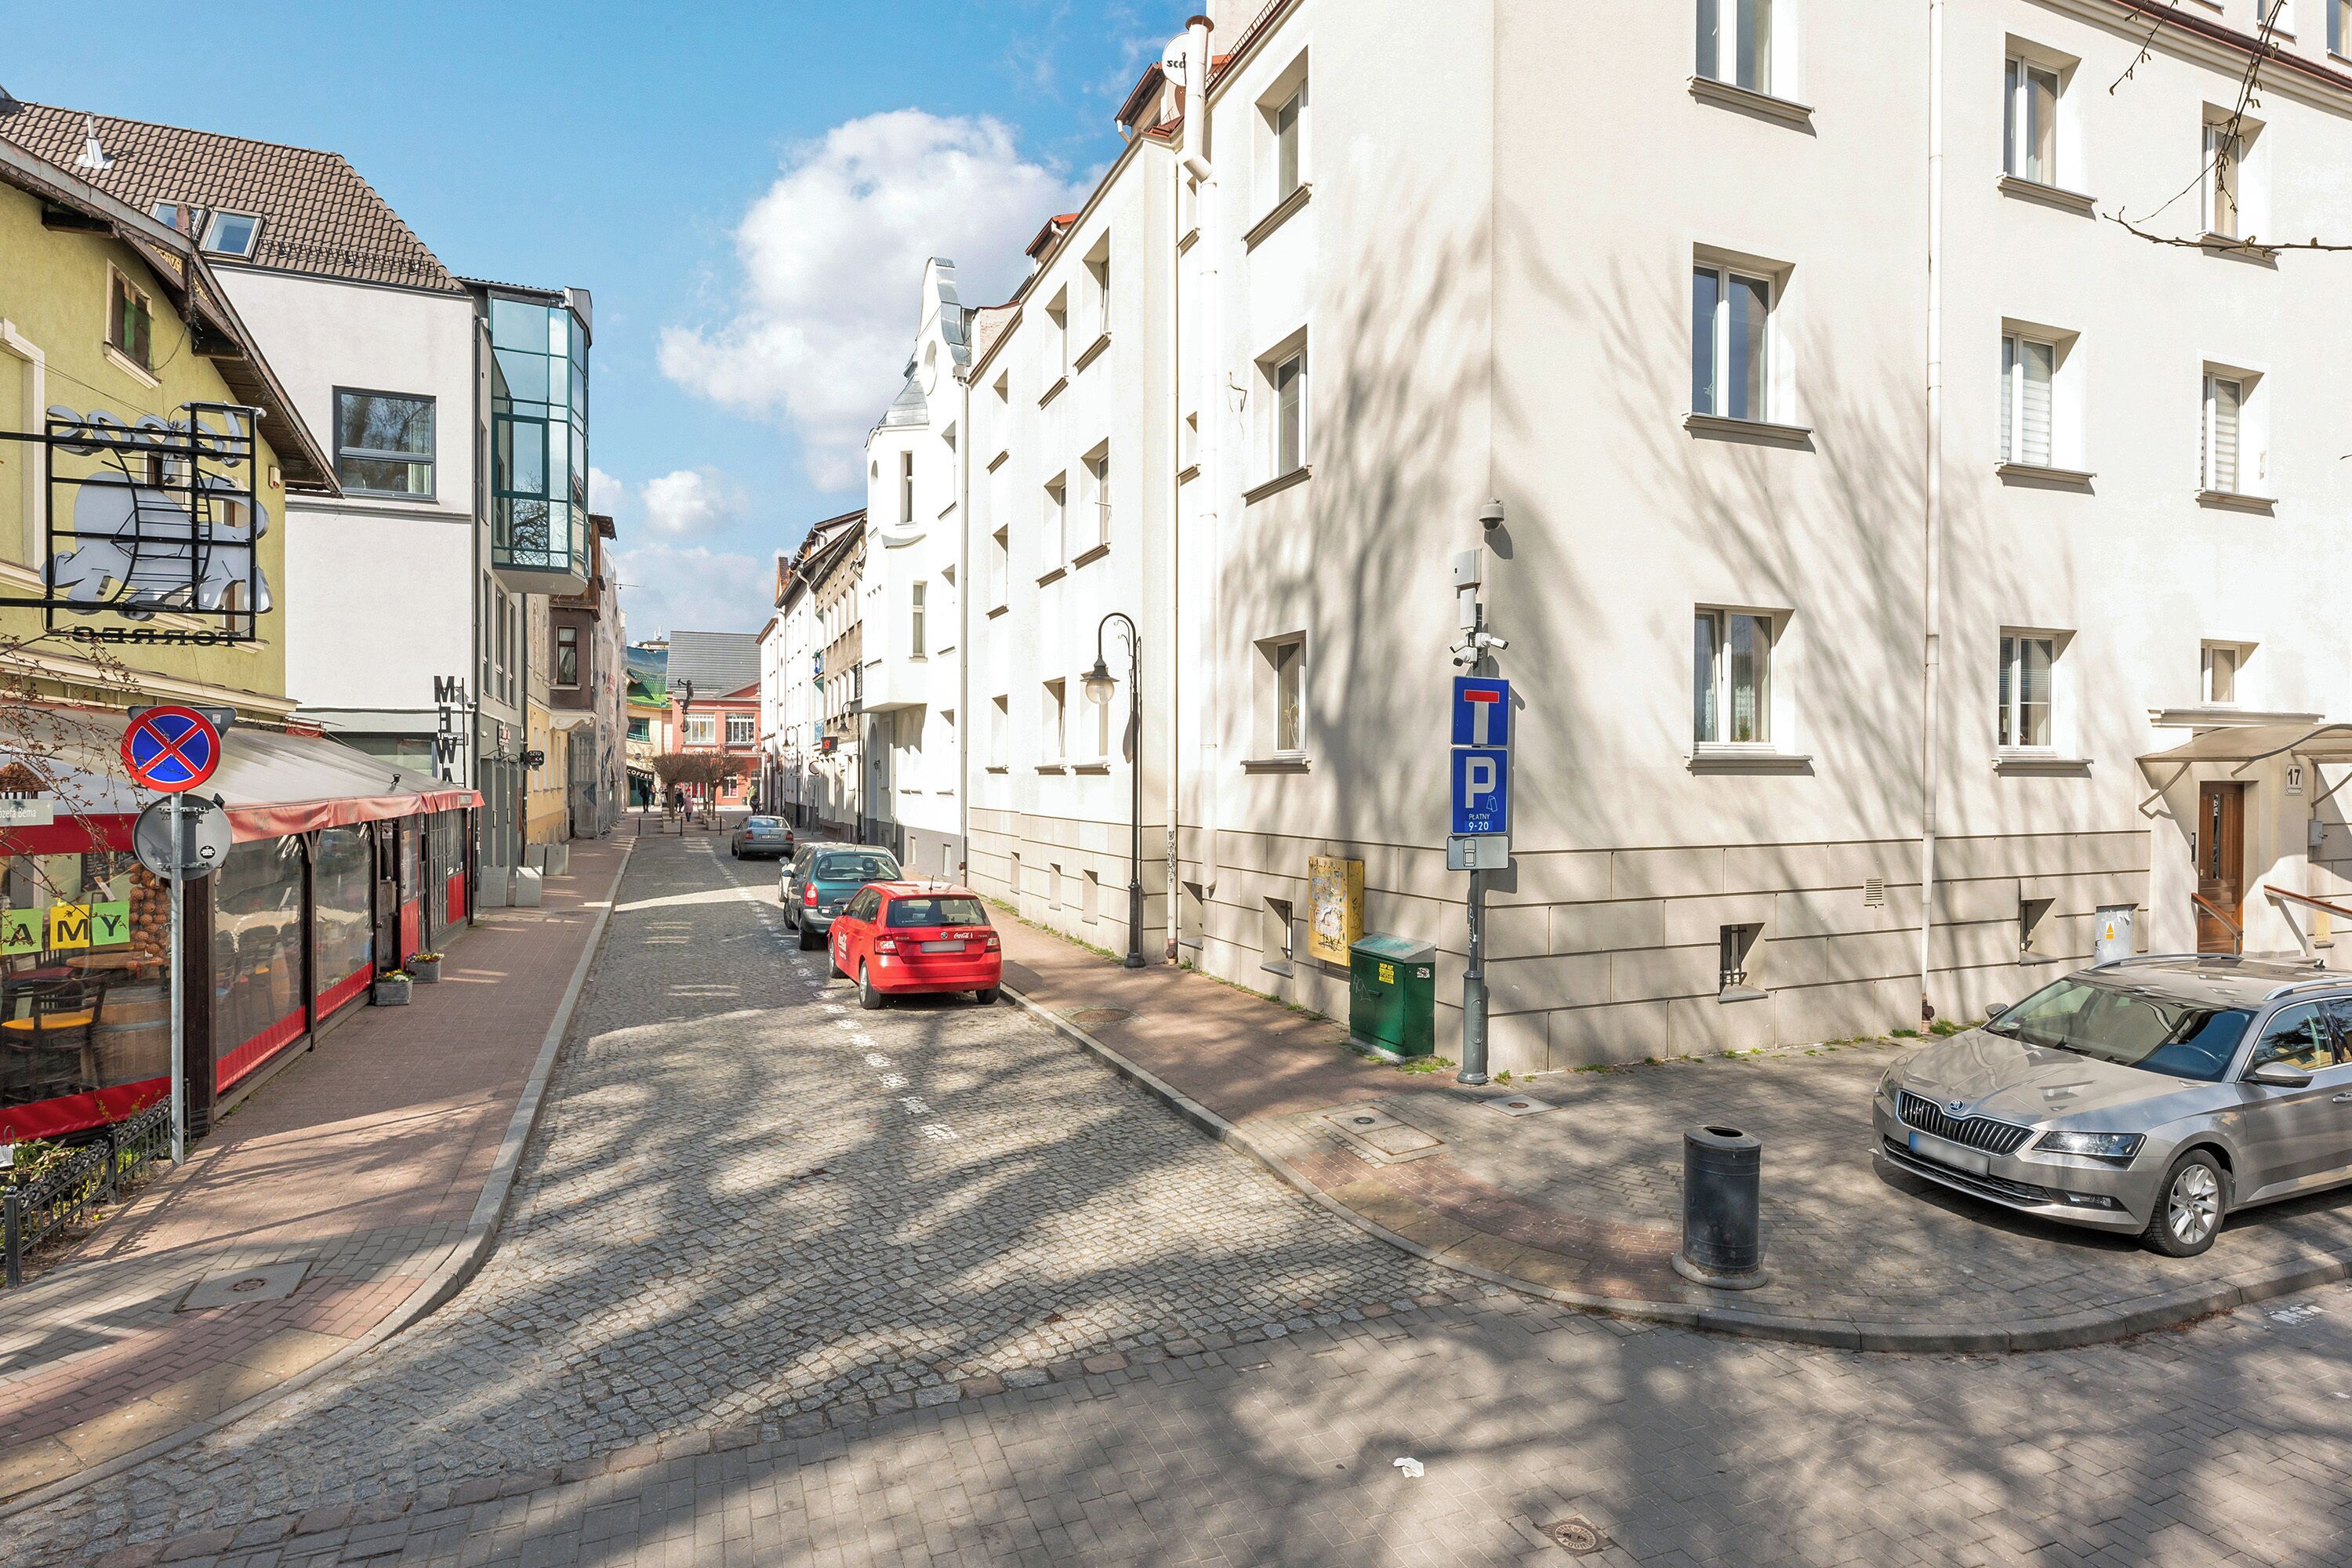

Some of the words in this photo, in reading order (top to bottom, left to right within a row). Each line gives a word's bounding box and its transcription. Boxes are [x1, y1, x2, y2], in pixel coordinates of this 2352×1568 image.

[627, 768, 652, 780] COFFEE
[2288, 768, 2301, 786] 17
[1465, 757, 1497, 808] P
[1468, 822, 1489, 831] 9-20
